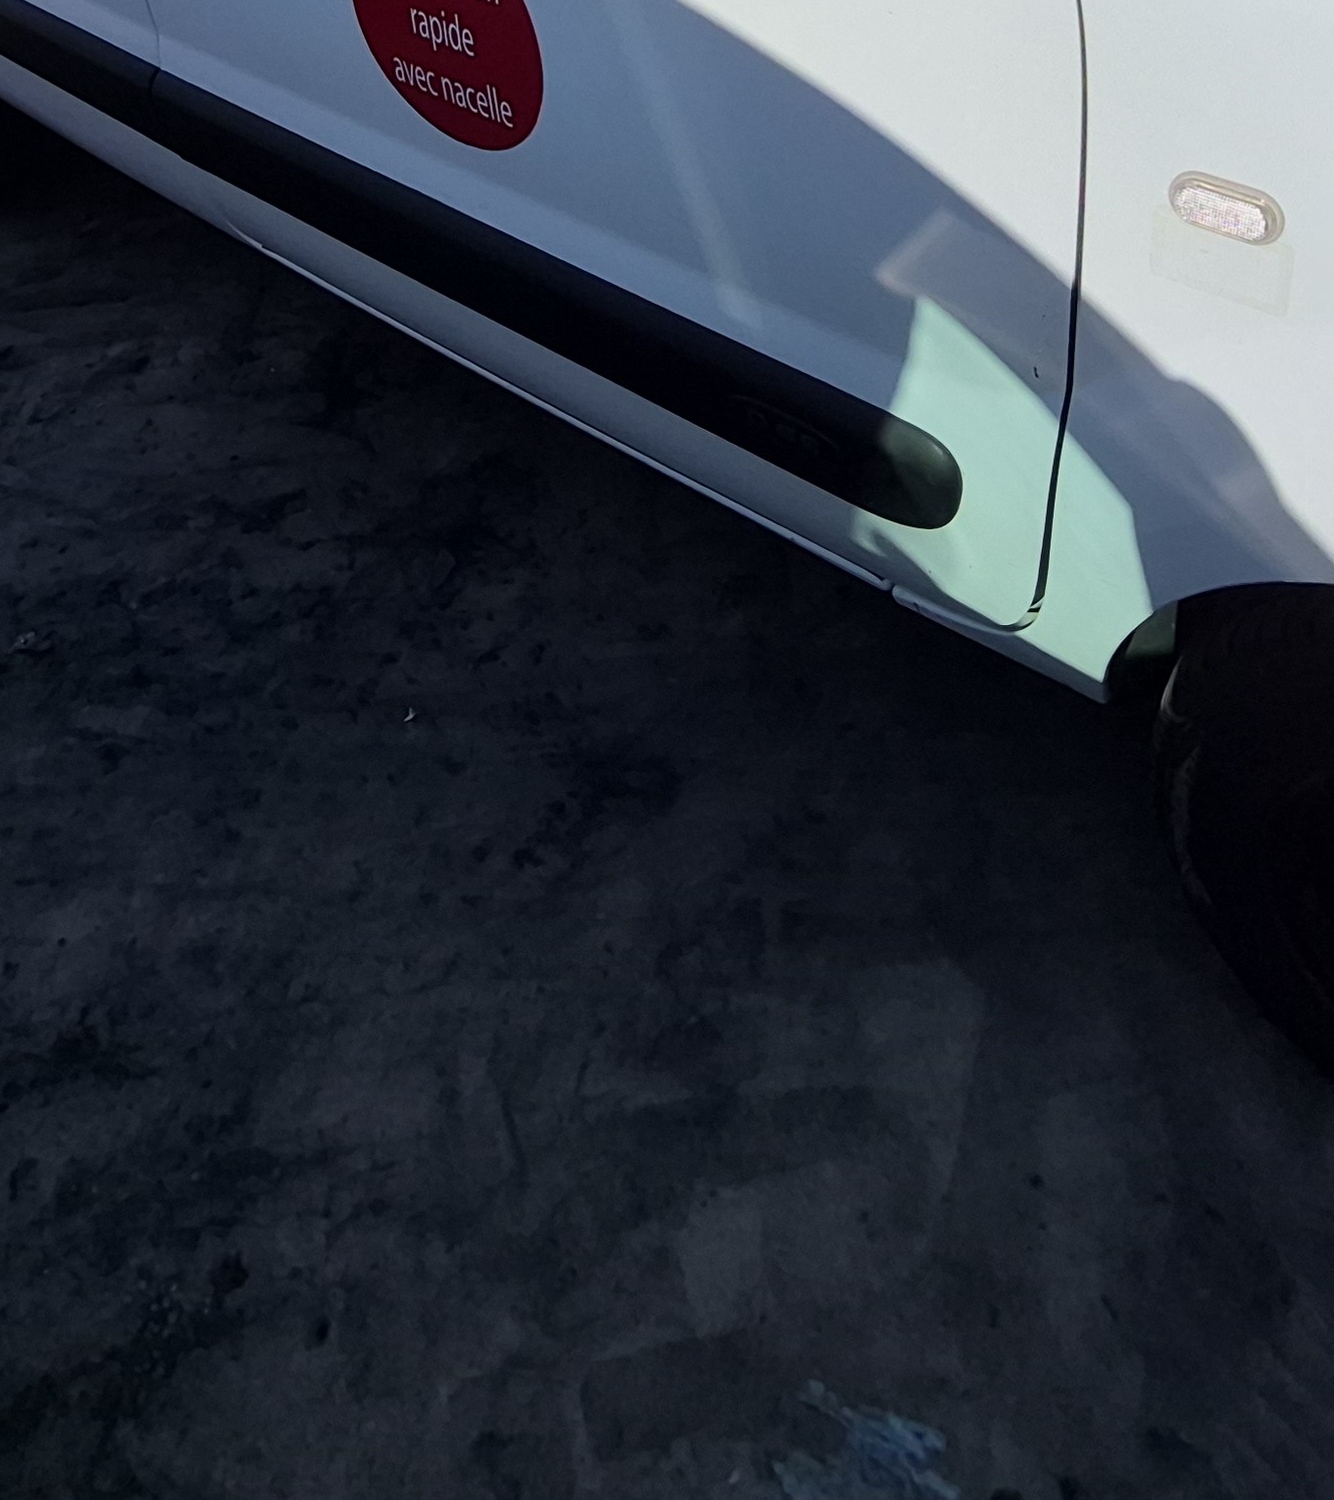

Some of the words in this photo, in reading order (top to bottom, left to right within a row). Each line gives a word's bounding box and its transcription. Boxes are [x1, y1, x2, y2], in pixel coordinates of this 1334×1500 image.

[410, 7, 475, 57] rapide
[393, 57, 439, 97] avec
[441, 76, 513, 128] nacelle
